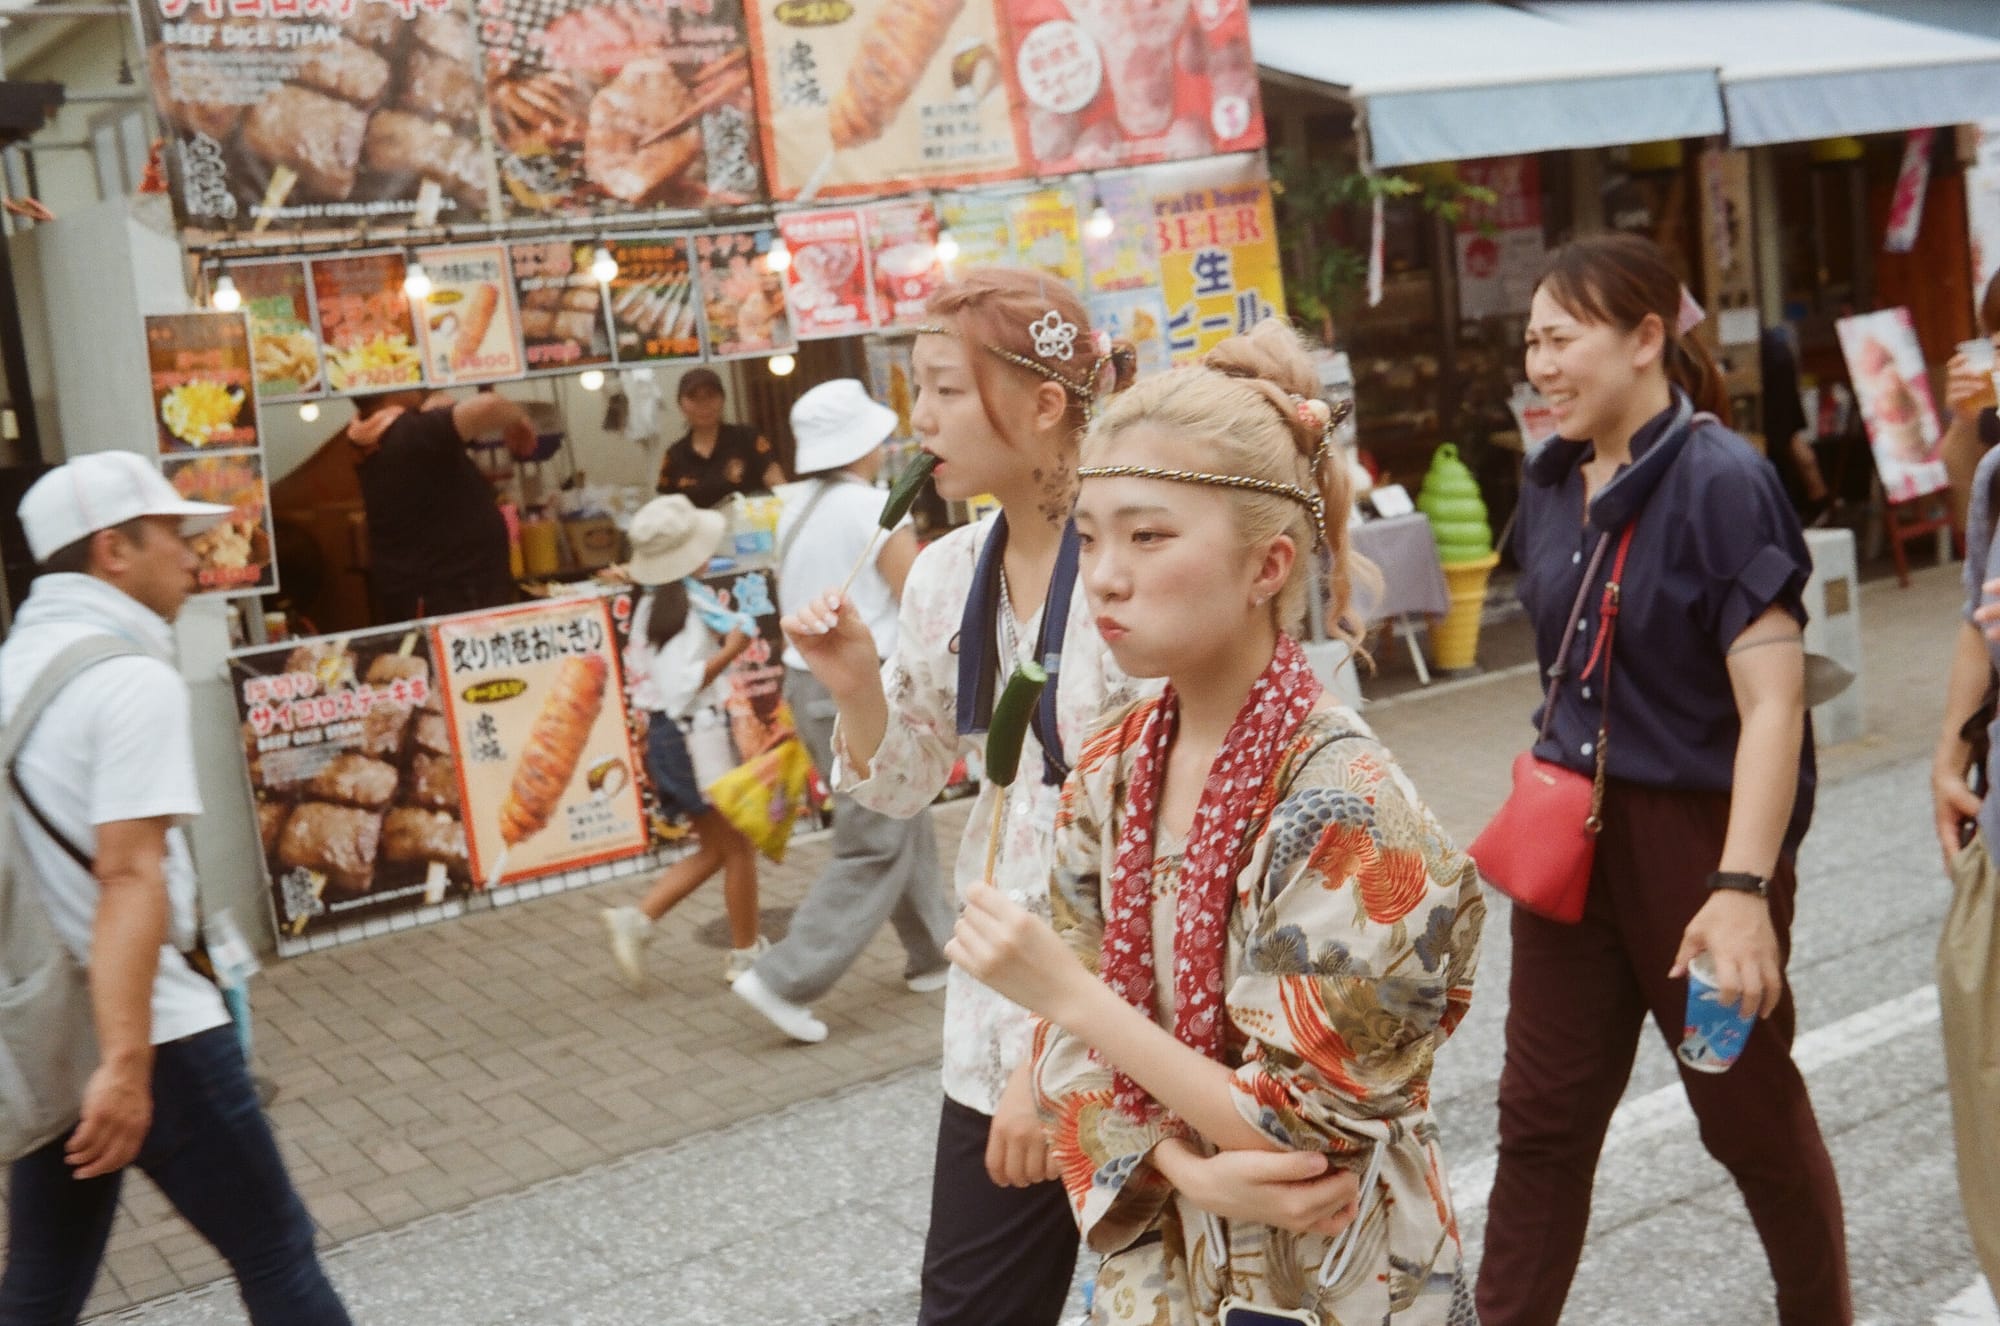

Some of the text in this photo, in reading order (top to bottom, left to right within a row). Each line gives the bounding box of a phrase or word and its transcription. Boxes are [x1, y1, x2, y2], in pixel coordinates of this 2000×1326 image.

[1194, 250, 1232, 295] 生
[248, 676, 430, 736] サイコロステーキ串
